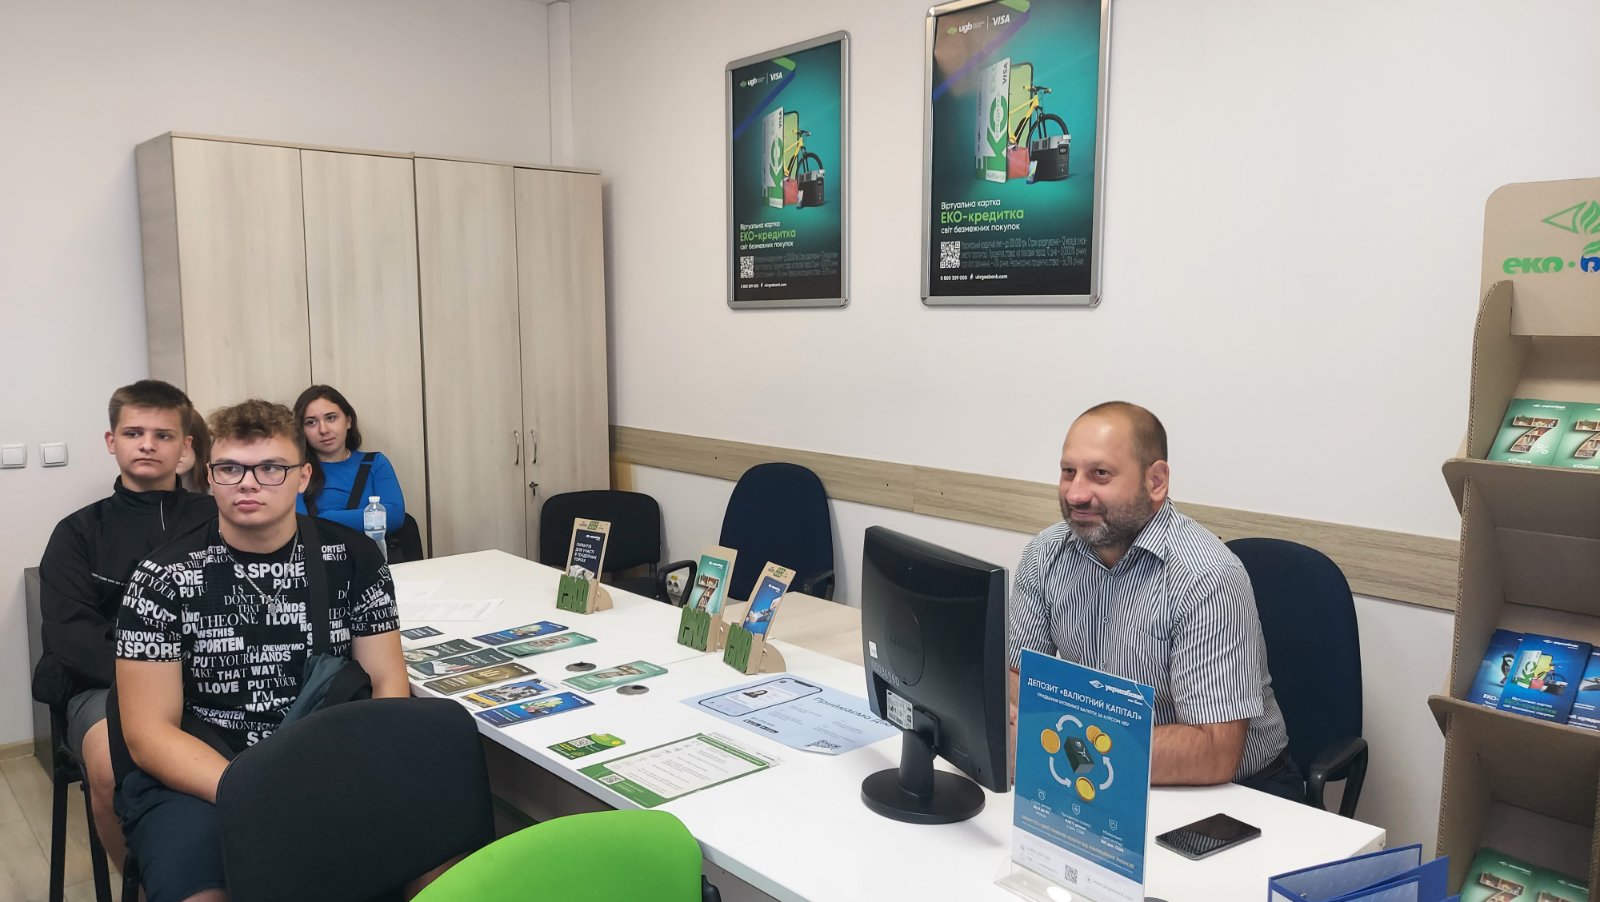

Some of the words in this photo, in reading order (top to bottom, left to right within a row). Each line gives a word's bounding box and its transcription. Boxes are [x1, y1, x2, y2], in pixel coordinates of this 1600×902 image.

[992, 14, 1010, 26] VISA
[958, 22, 972, 34] ugb
[748, 77, 758, 87] ugb
[770, 72, 782, 82] VISA
[941, 202, 976, 210] Віртуальна
[978, 200, 1001, 208] картка
[940, 209, 1024, 224] ЕКО-кредитка
[940, 226, 952, 234] світ
[953, 224, 989, 233] безмежних
[991, 222, 1020, 233] покупок
[740, 230, 796, 242] ЕКО-кредитка
[248, 562, 306, 578] SPORE
[124, 642, 182, 658] SPORE
[193, 637, 244, 654] SPORTEN
[205, 681, 240, 694] LOVE
[252, 690, 274, 703] I'M
[1028, 676, 1058, 695] ДЕПОЗИТ
[1060, 691, 1105, 710] «ВАЛЮТНИЙ
[1105, 704, 1142, 724] КАПІТАЛ»
